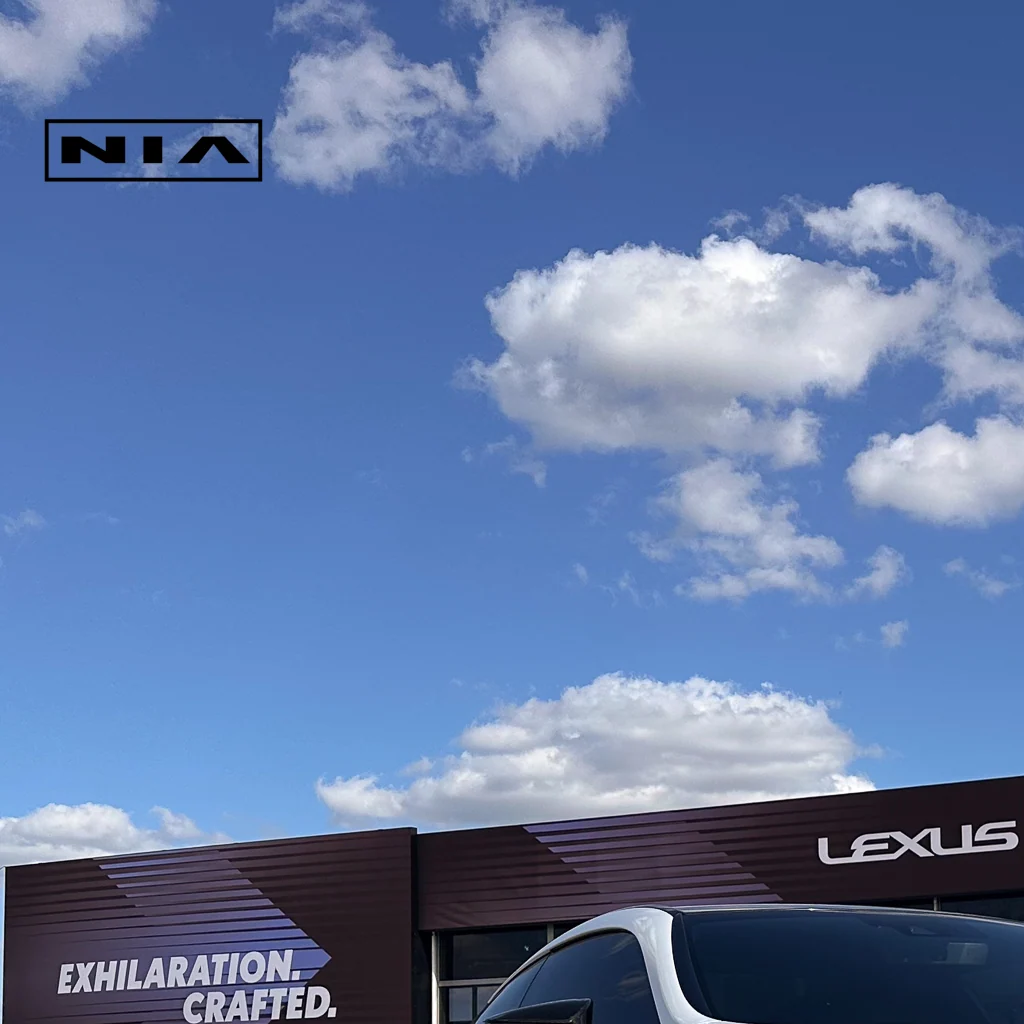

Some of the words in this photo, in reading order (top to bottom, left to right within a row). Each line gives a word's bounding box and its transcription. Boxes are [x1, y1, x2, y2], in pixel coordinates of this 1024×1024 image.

[818, 820, 1019, 865] LEXUS
[58, 949, 301, 994] EXHILARATION.
[183, 986, 337, 1024] CRAFTED.
